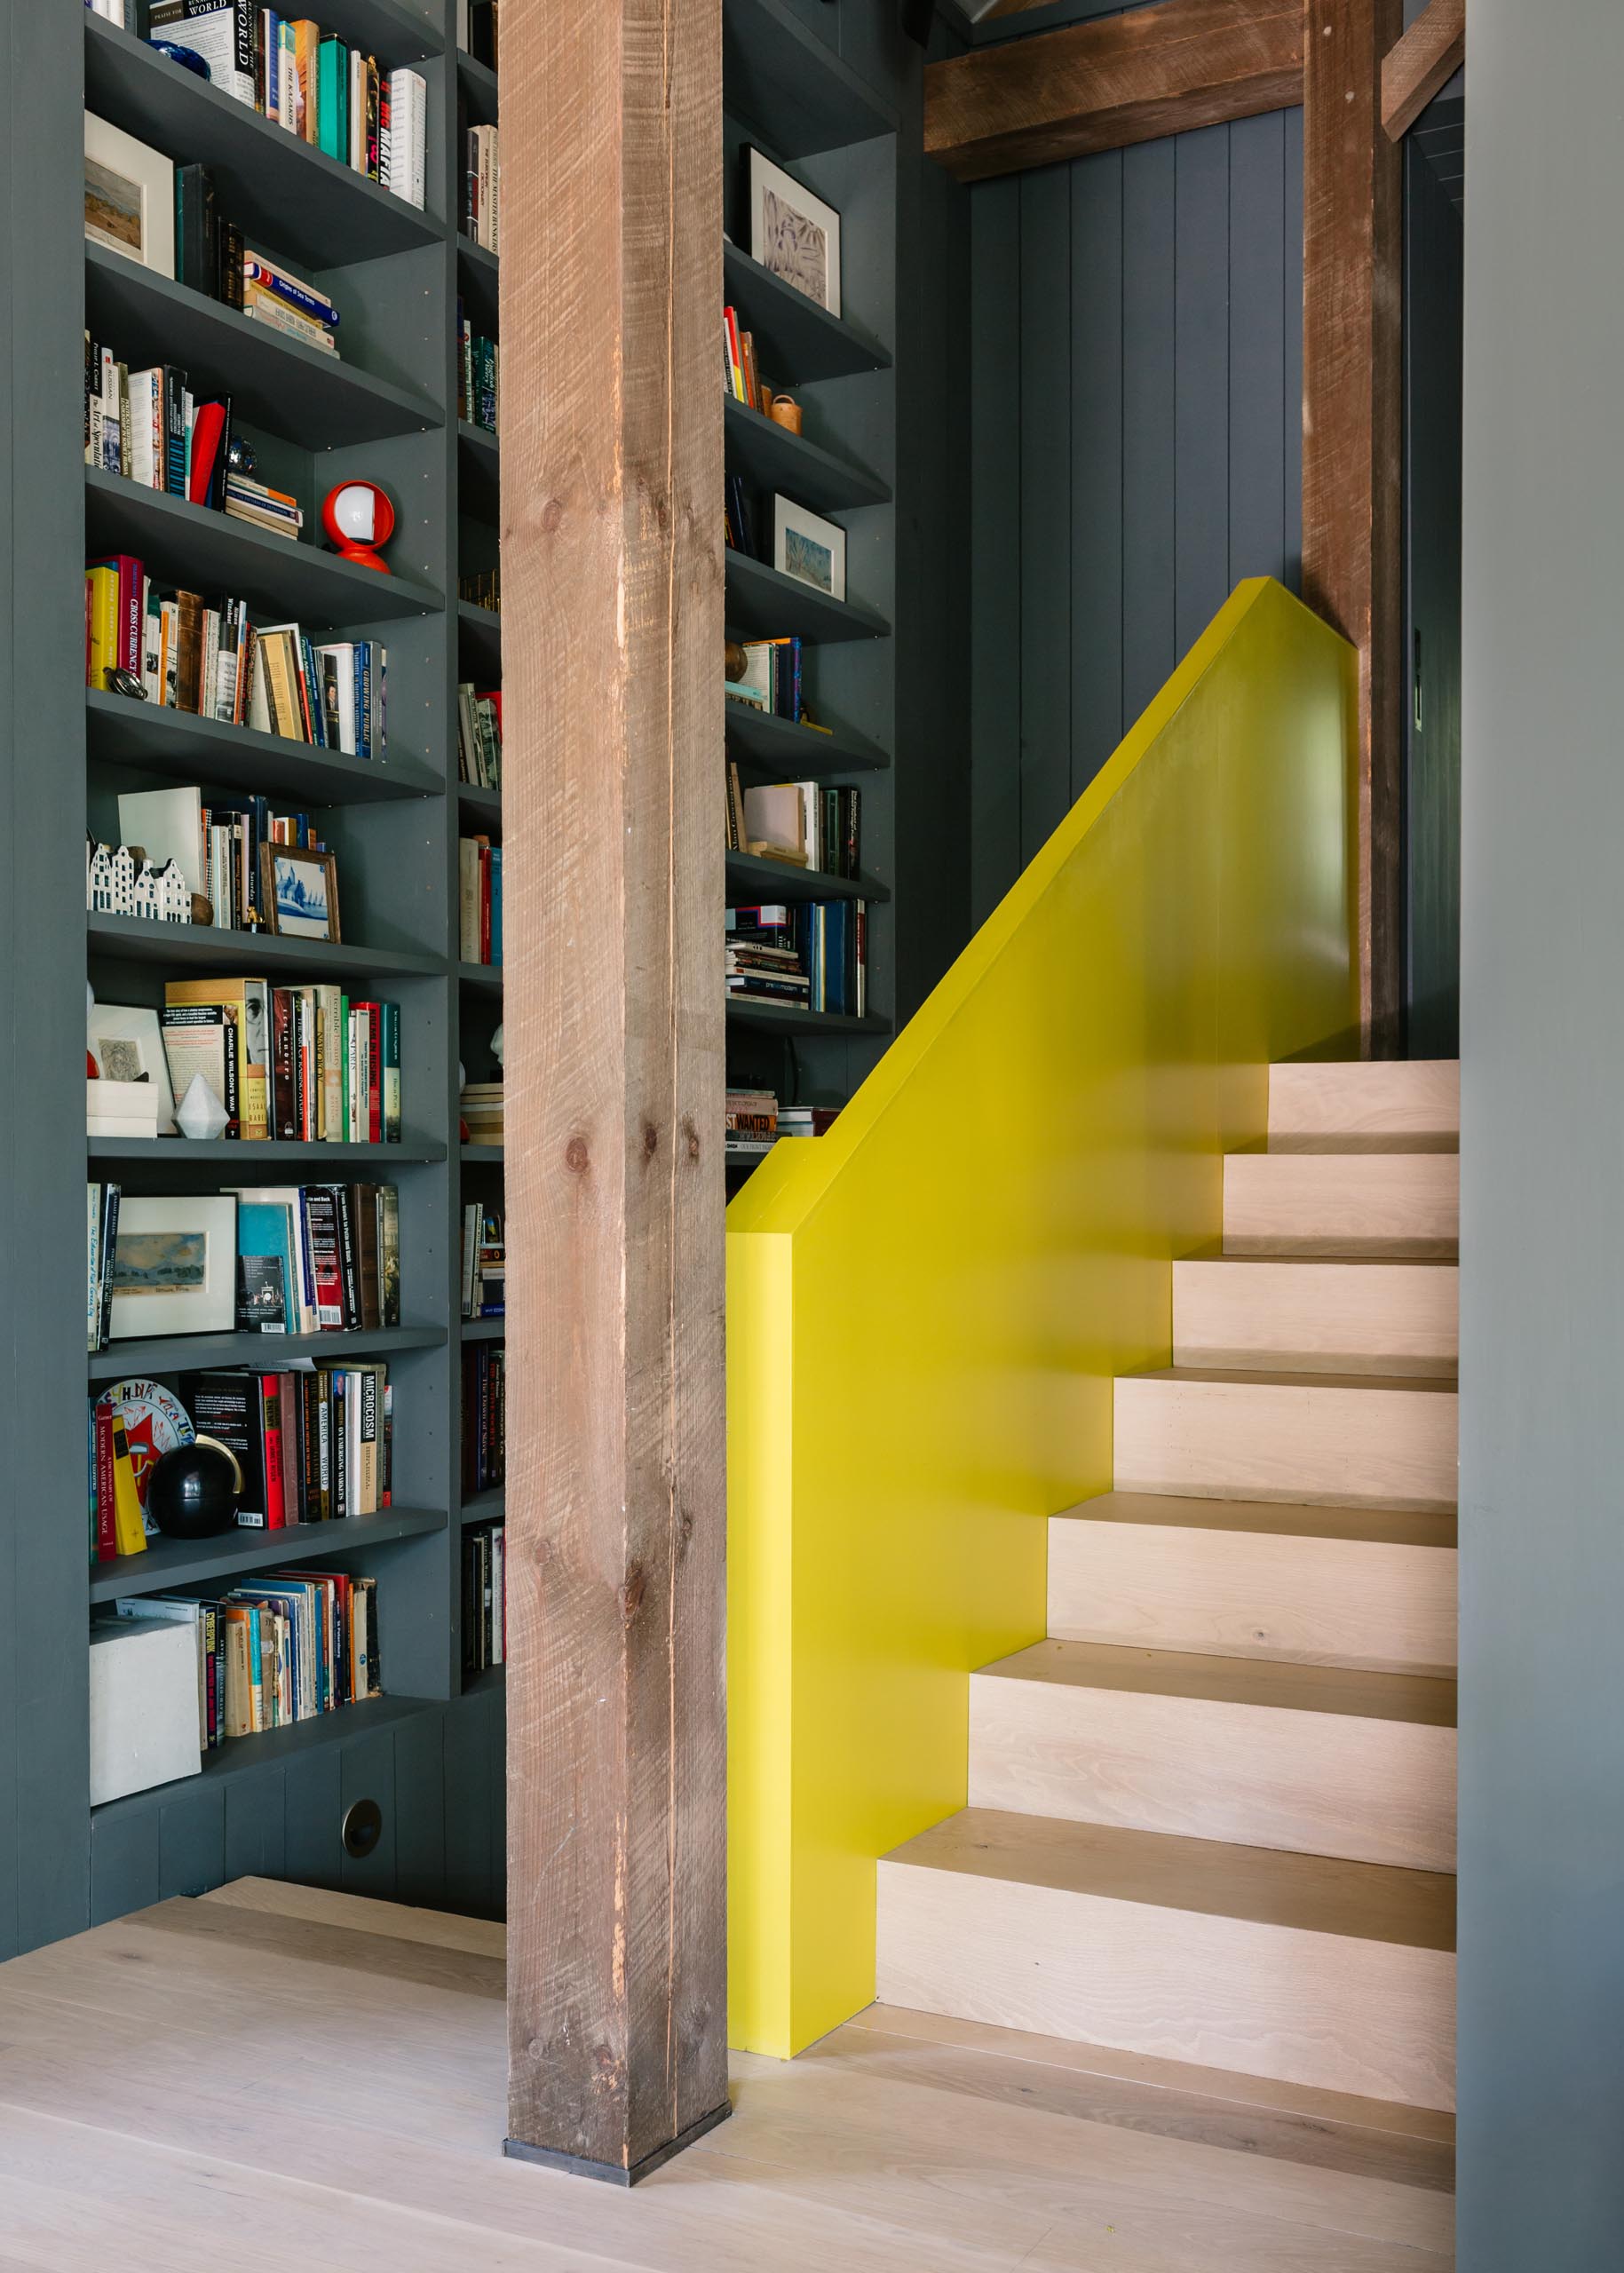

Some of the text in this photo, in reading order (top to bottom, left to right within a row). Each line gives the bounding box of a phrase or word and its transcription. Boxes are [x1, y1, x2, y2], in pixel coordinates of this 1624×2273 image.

[189, 0, 226, 16] WORLD
[238, 0, 249, 66] WORLD
[130, 598, 139, 624] CROSS
[129, 625, 139, 670] CURRENCY
[726, 1113, 736, 1130] ST
[365, 1375, 375, 1438] MICROCOSM
[337, 1426, 345, 1437] ON
[206, 1612, 215, 1653] CYBERPUNK
